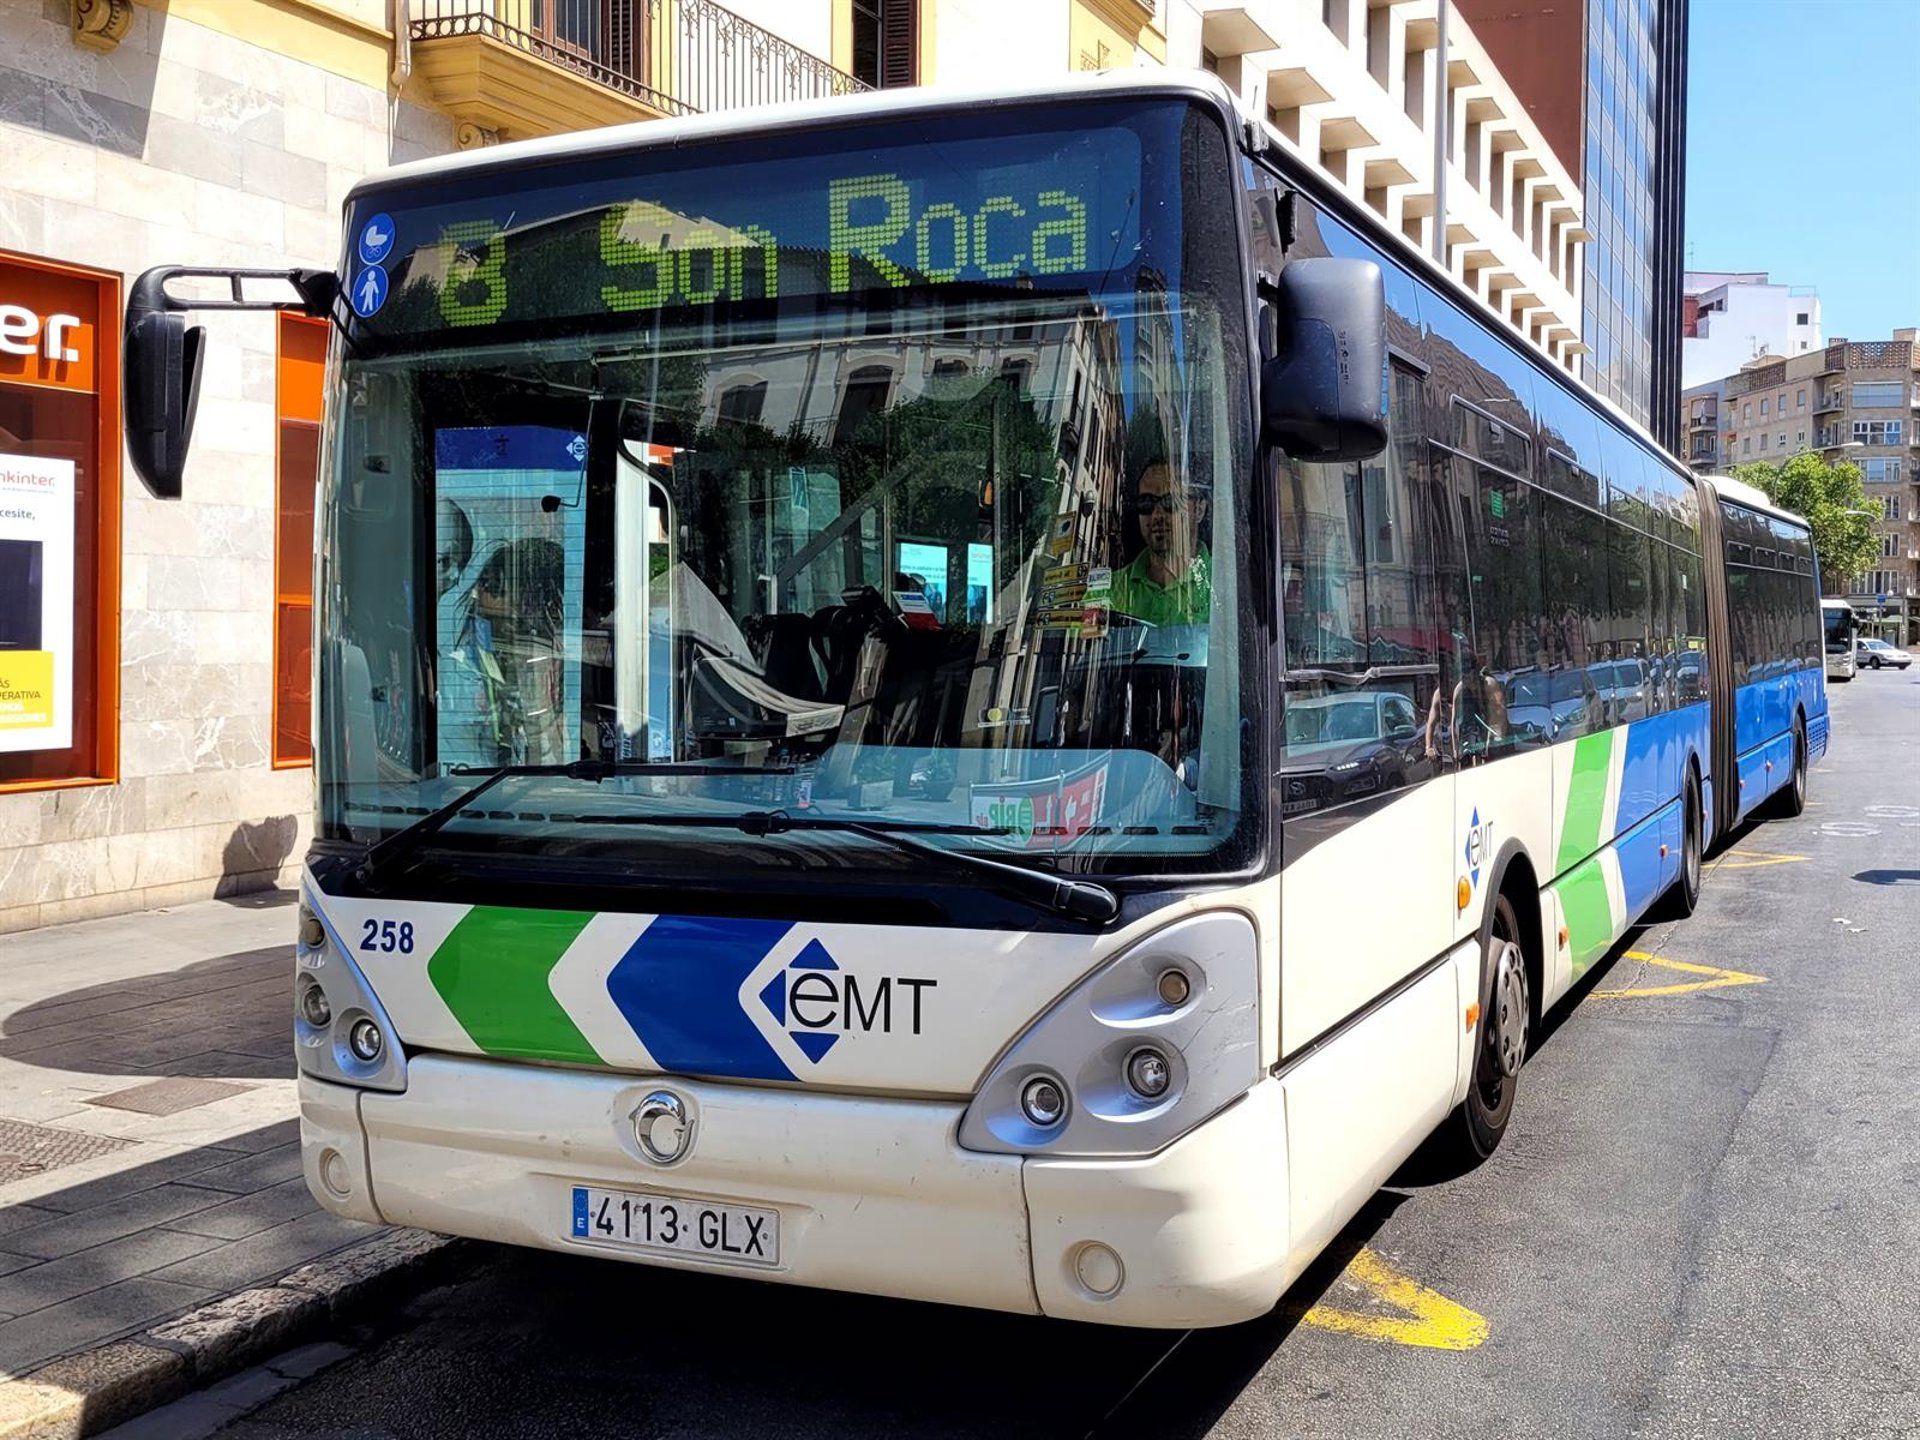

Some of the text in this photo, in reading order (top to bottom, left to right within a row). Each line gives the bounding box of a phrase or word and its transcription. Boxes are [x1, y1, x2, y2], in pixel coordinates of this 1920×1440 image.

[600, 201, 777, 312] Son
[829, 174, 1086, 293] Roca
[0, 690, 41, 700] ERATIVA
[360, 918, 414, 954] 258
[596, 1197, 679, 1244] 4113
[700, 1210, 764, 1256] GLX
